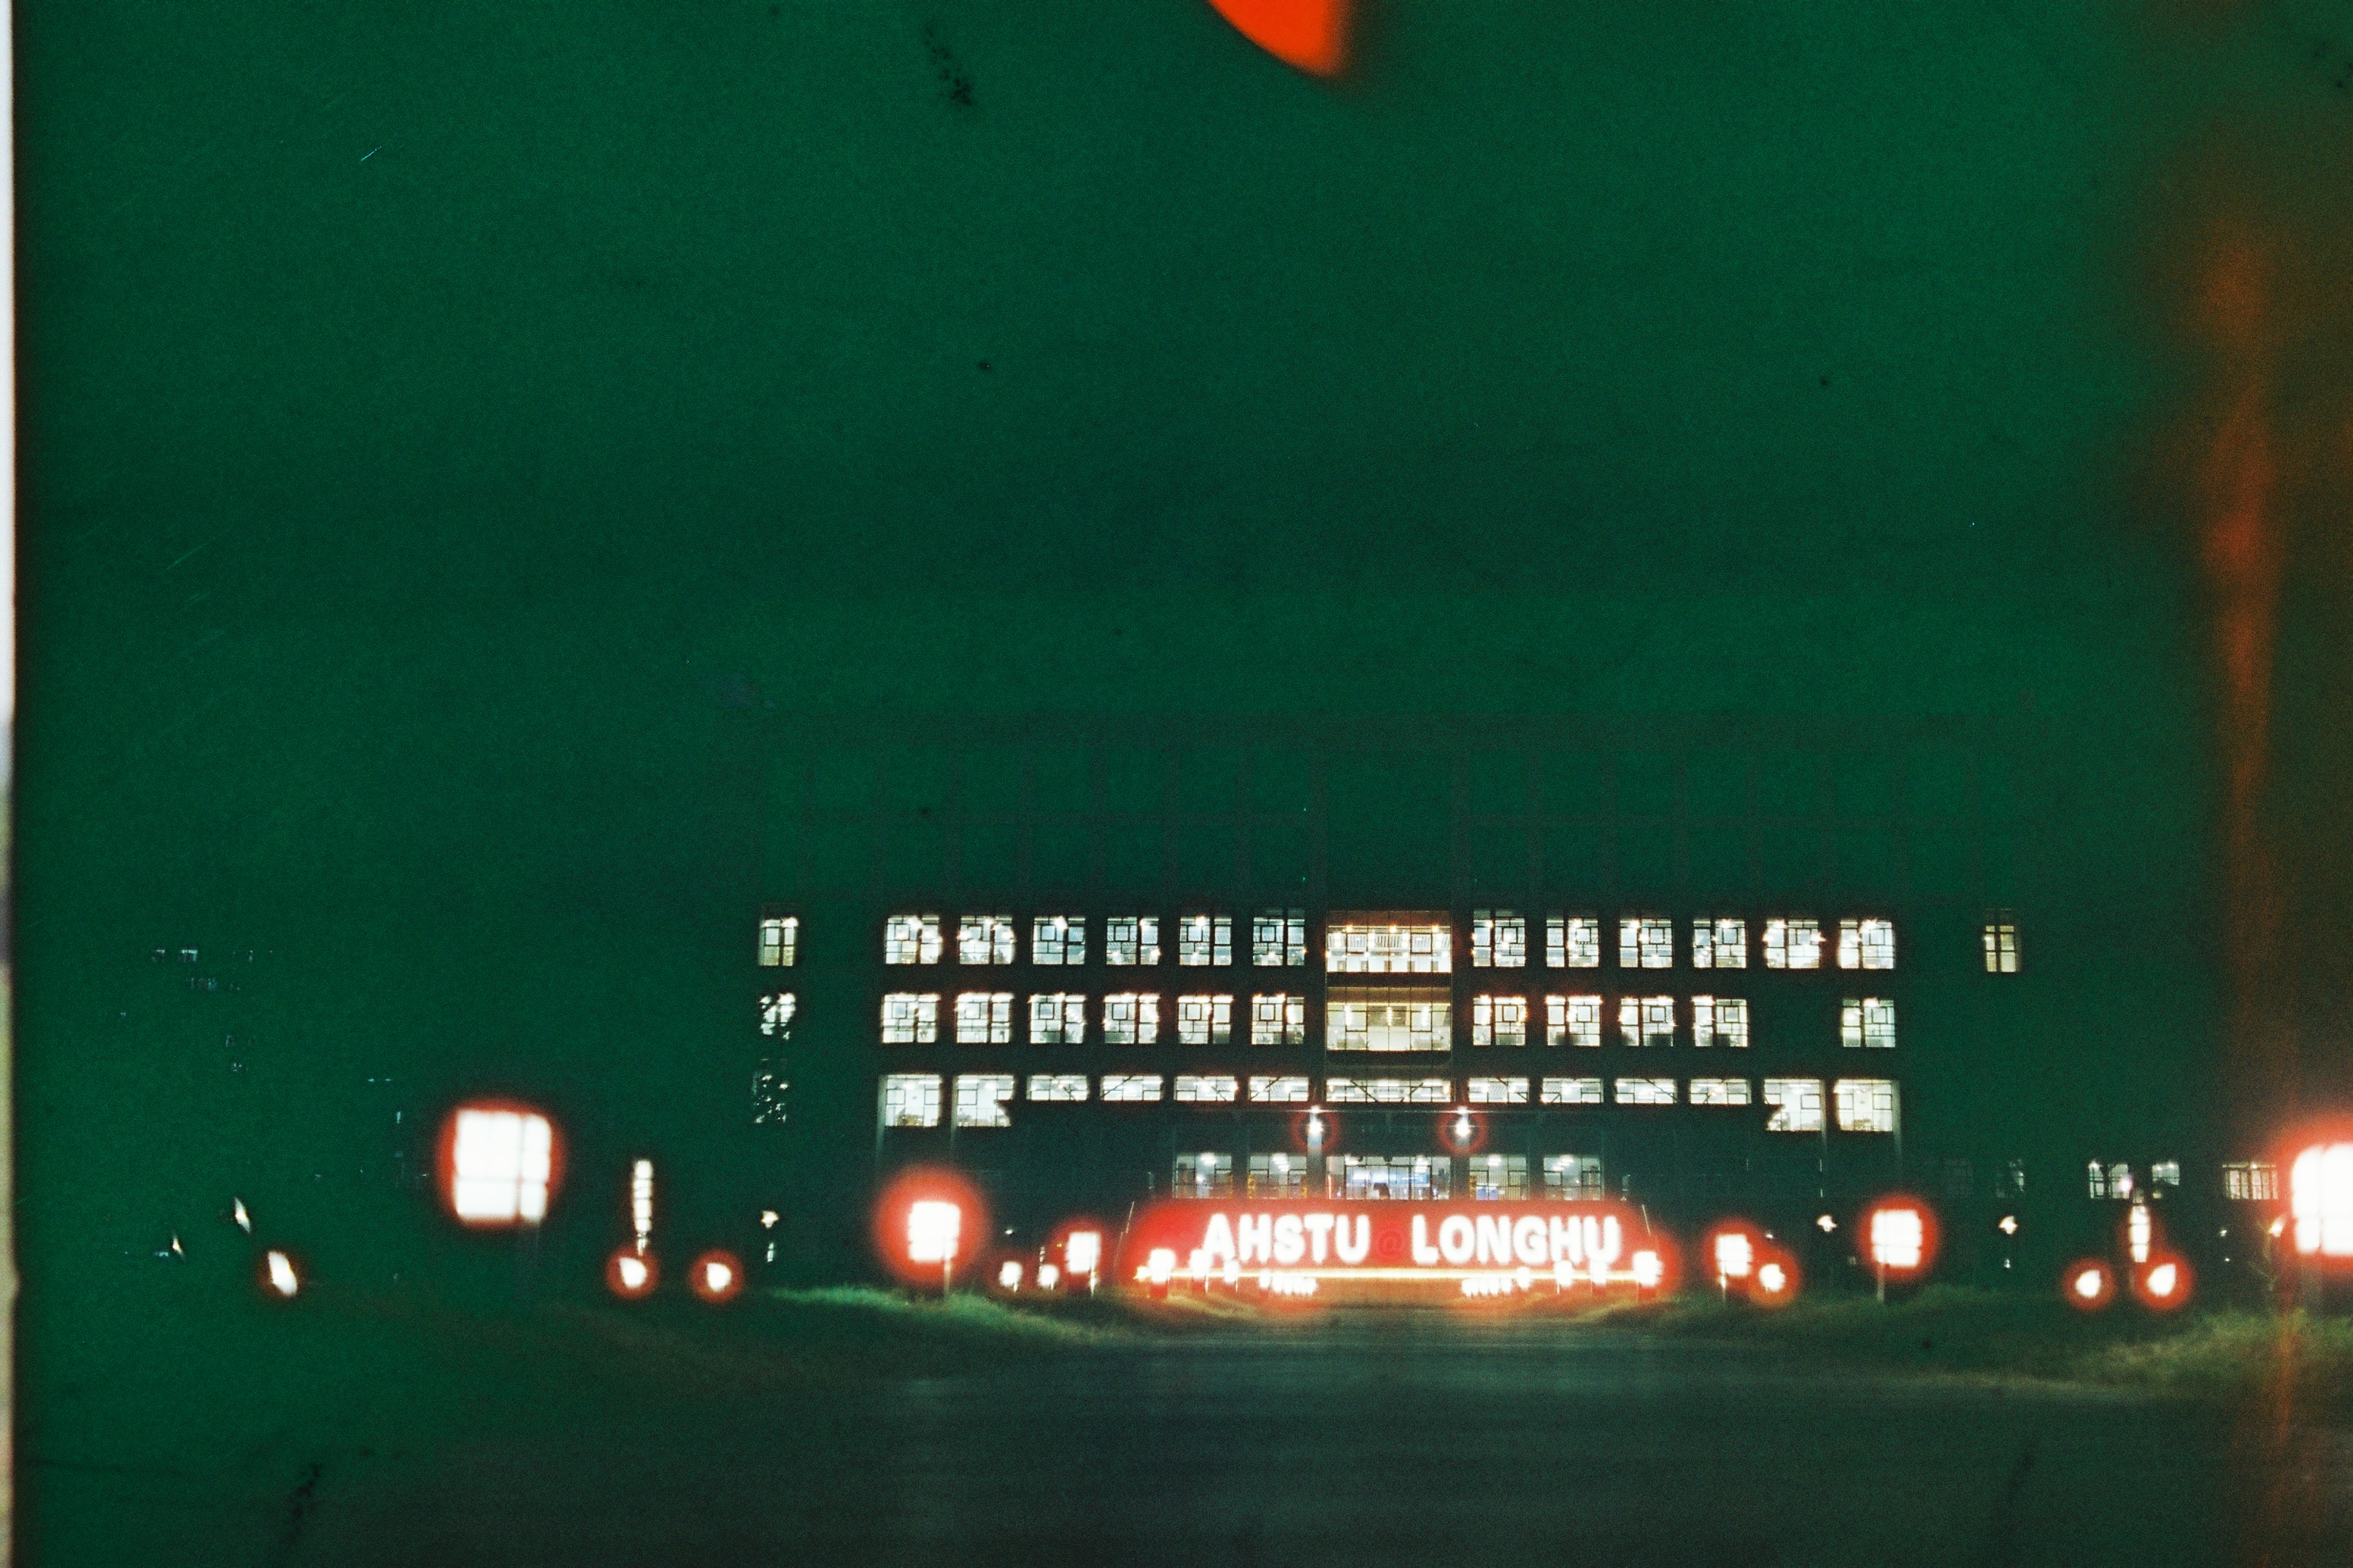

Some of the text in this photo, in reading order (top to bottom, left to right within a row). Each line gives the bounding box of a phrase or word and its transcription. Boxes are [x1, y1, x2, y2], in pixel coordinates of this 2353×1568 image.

[1203, 1213, 1620, 1265] AHSTU @ LONGHU
